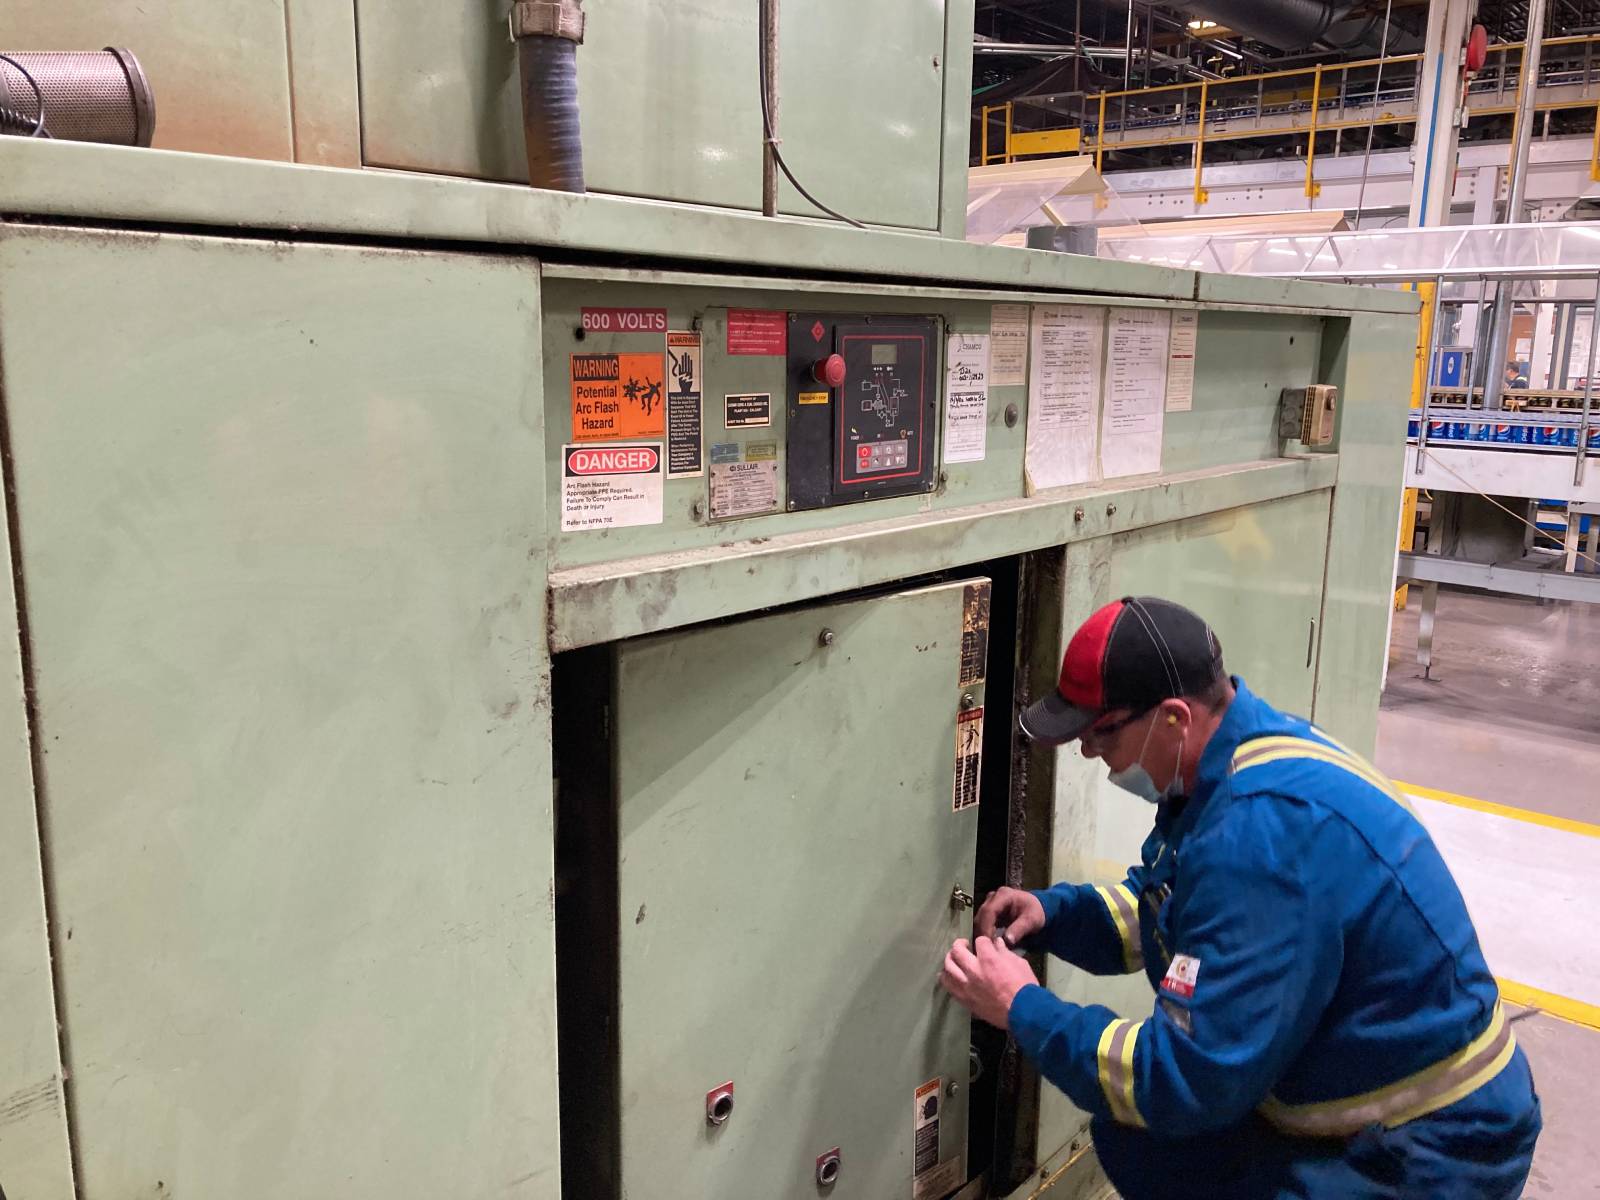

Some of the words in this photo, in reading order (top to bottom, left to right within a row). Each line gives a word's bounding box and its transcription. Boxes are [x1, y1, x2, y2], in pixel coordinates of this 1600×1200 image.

[582, 313, 610, 329] 600
[617, 313, 665, 329] VOLTS
[573, 359, 619, 378] WARNING
[576, 385, 617, 399] Potential
[575, 402, 592, 414] Arc
[594, 401, 619, 414] Flash
[582, 417, 614, 430] Hazard
[576, 452, 651, 471] DANGER
